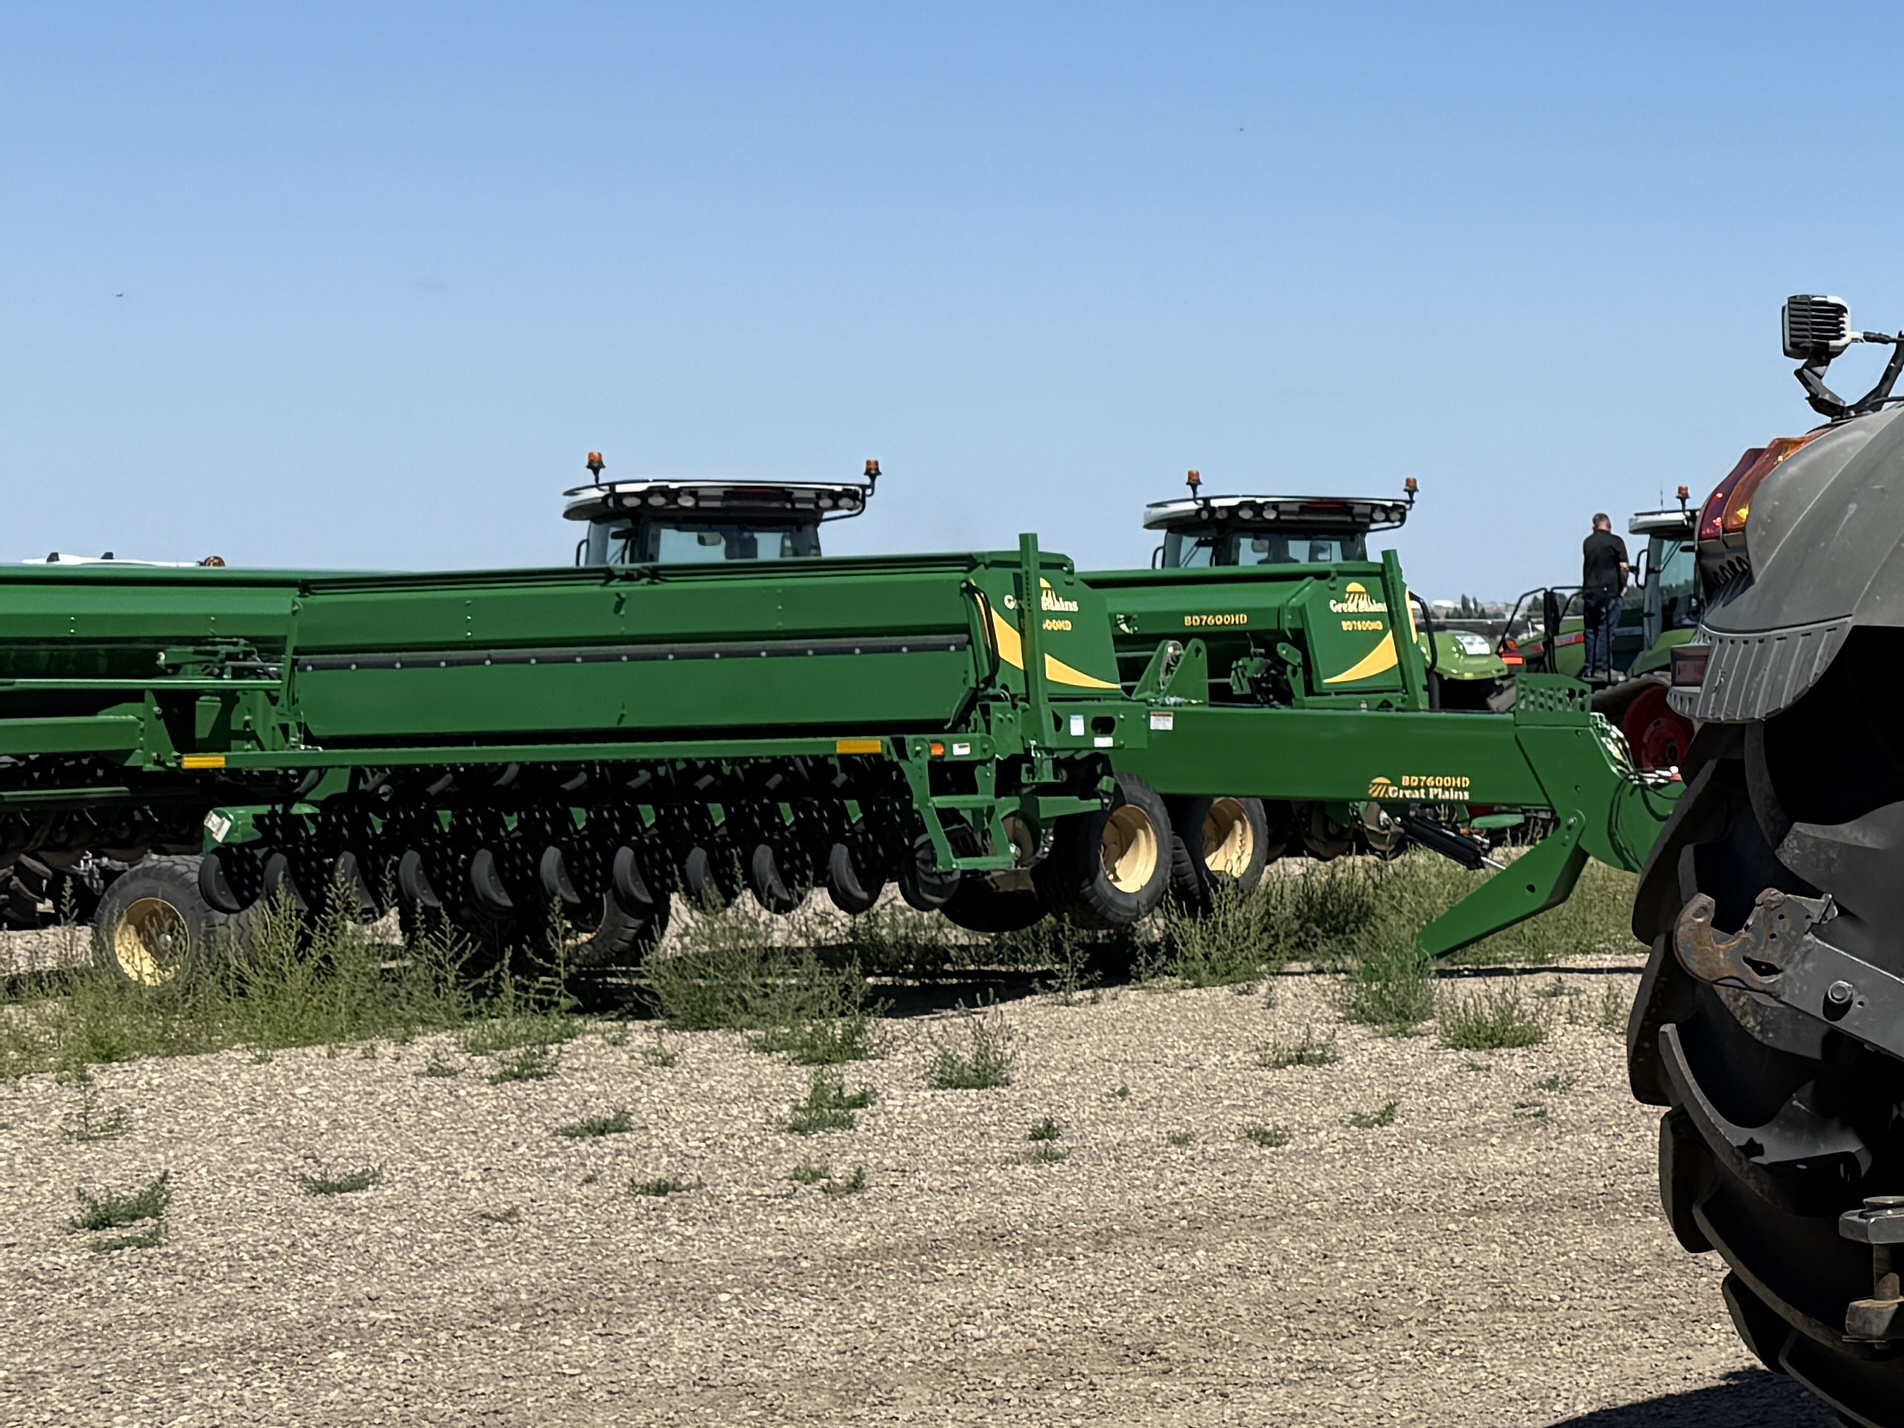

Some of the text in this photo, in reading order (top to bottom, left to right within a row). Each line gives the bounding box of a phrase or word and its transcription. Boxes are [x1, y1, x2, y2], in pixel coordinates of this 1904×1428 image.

[1184, 614, 1248, 626] BD7600HD
[1401, 775, 1470, 788] BD7600HD
[1387, 785, 1470, 801] Great Plains
